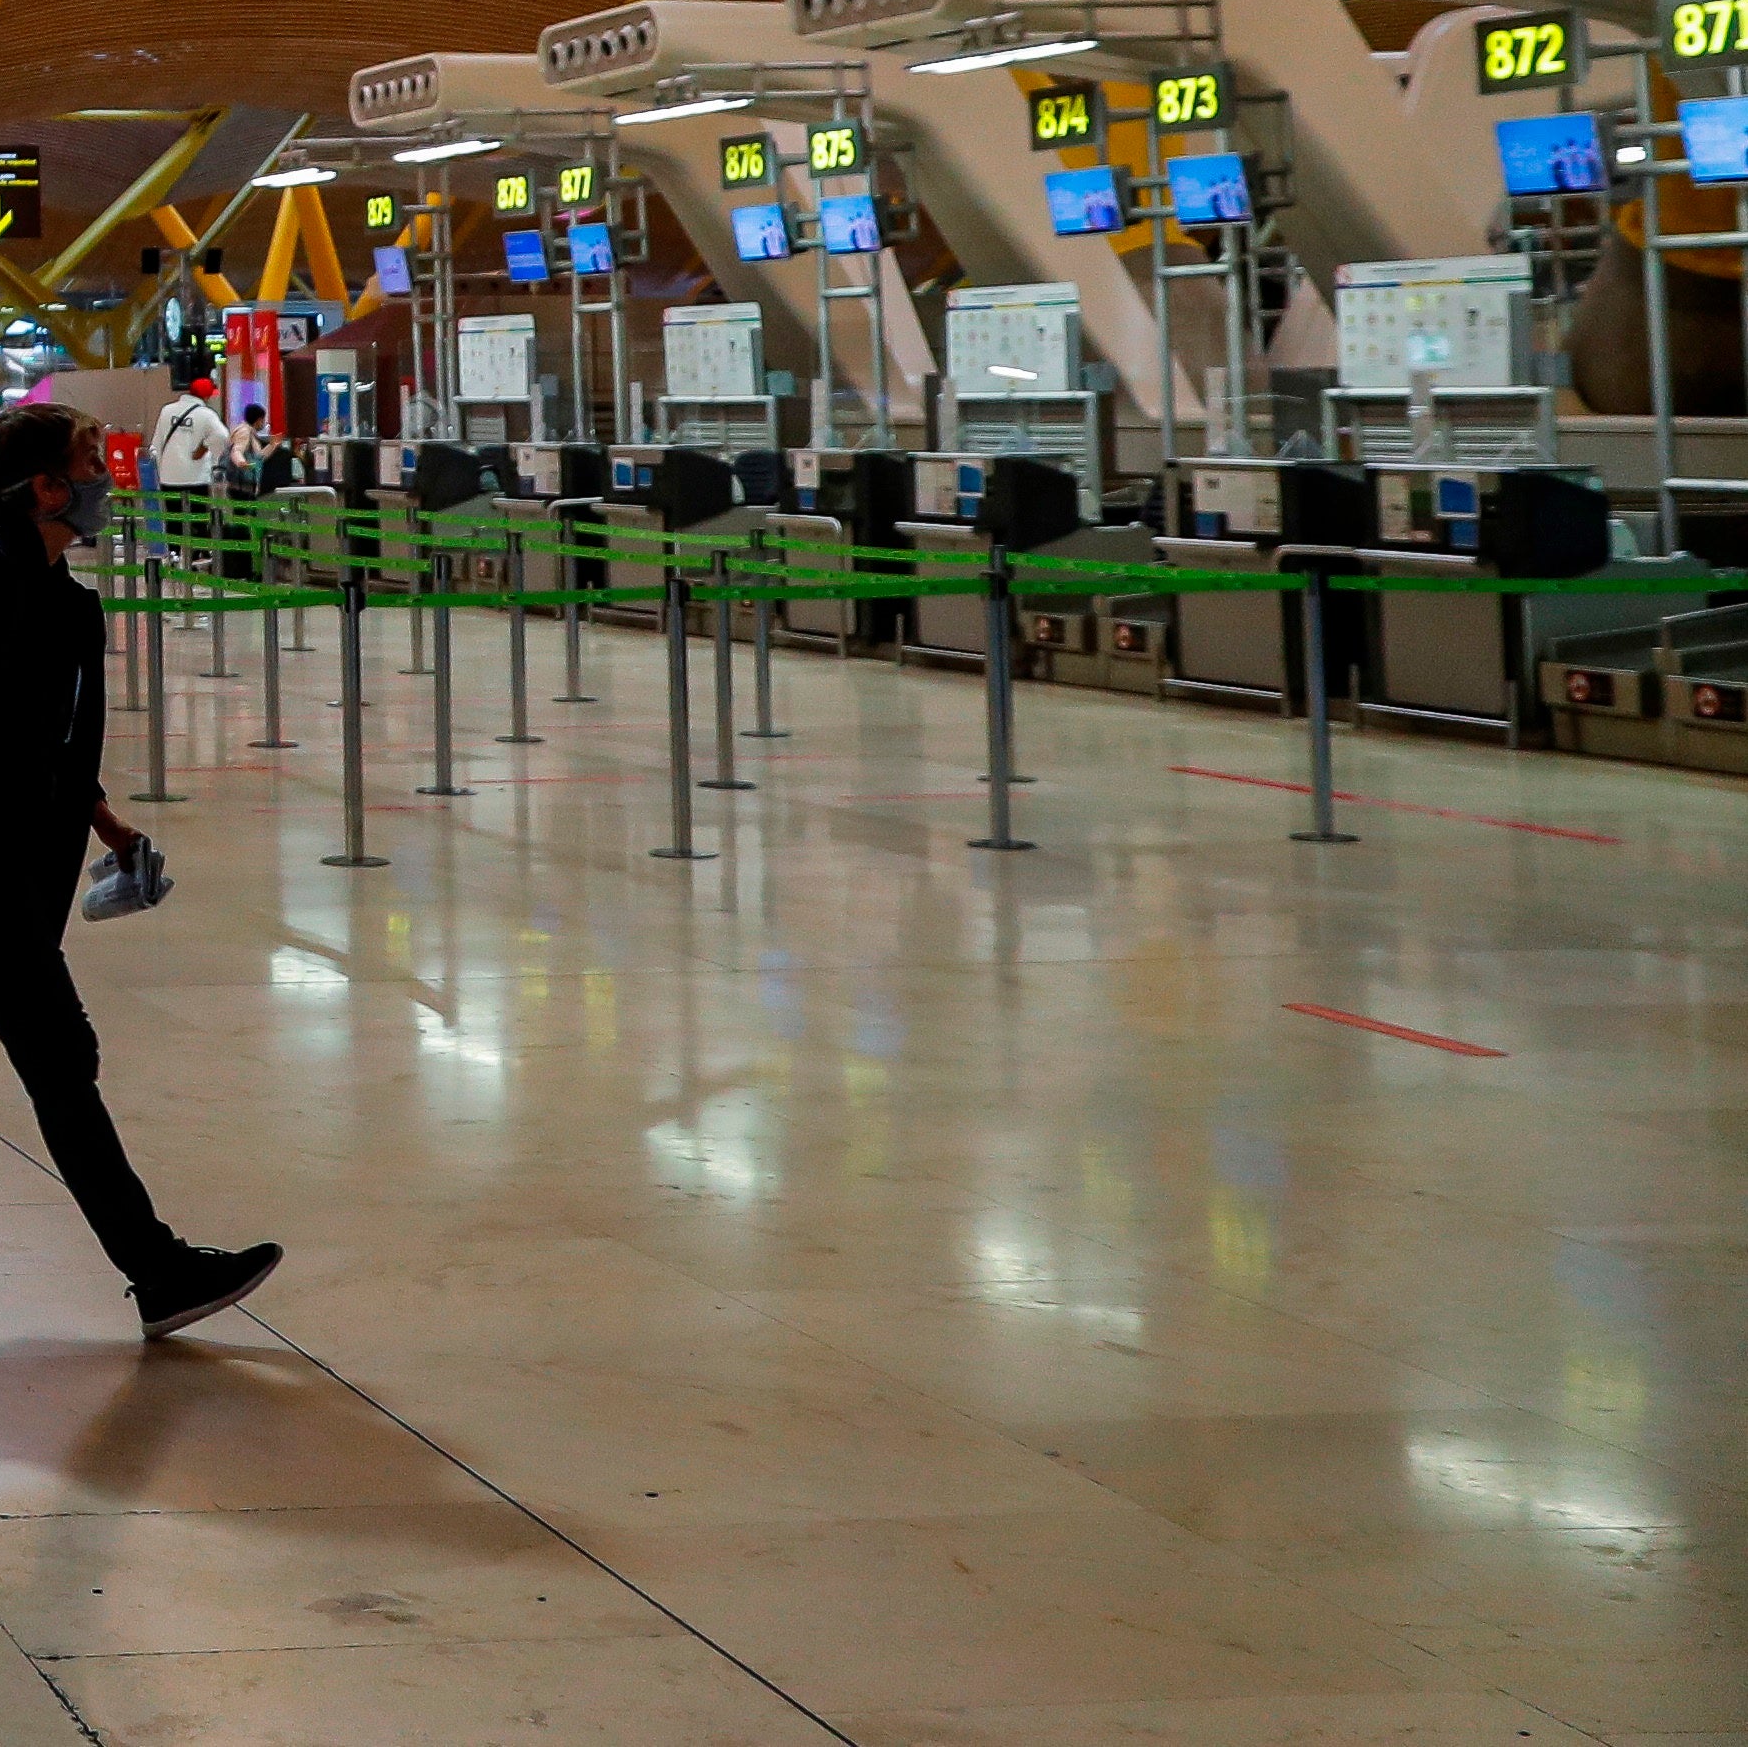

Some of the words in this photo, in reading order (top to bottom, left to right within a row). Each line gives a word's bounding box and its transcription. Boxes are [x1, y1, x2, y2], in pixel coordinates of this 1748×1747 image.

[1485, 23, 1565, 80] 872
[1037, 94, 1089, 139] 874
[1157, 75, 1219, 124] 873
[724, 144, 764, 181] 876
[811, 129, 855, 171] 875
[496, 178, 527, 212] 878
[559, 166, 592, 203] 877
[366, 196, 393, 228] 879
